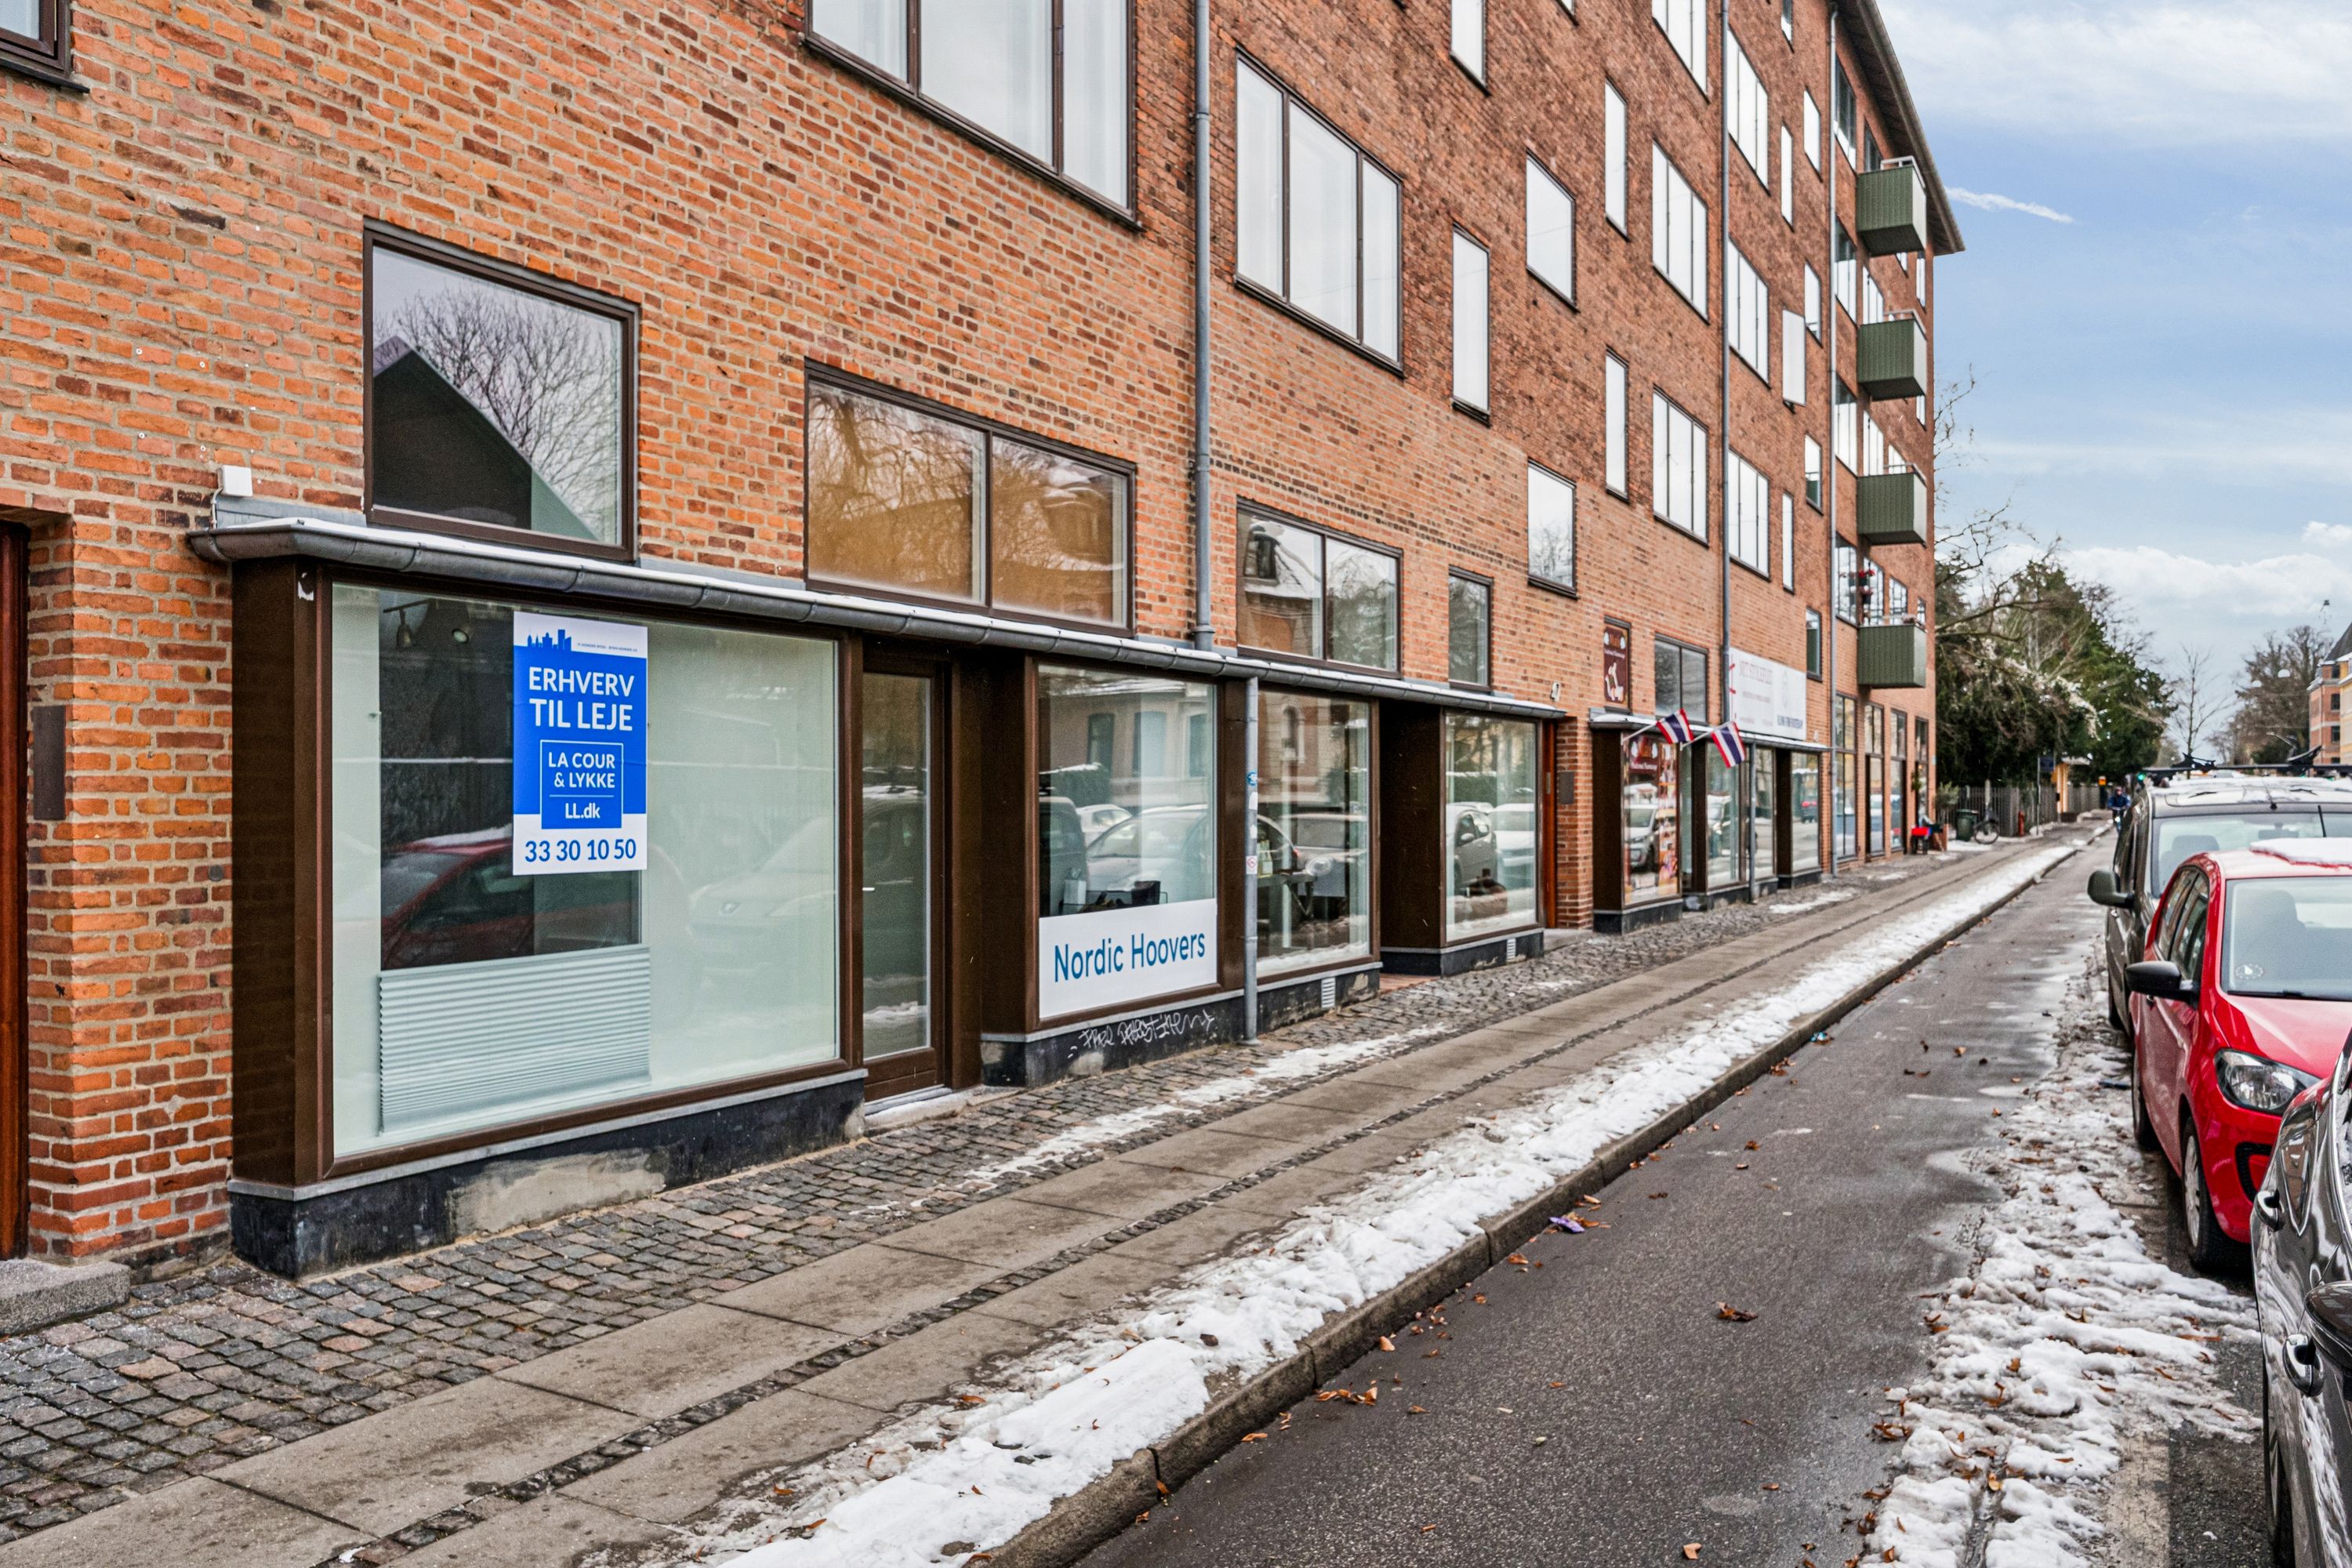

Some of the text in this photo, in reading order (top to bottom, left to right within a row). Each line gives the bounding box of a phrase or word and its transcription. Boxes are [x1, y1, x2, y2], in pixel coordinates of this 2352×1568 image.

[528, 666, 635, 697] ERHVERV
[528, 698, 633, 731] TIL LEJE
[548, 751, 615, 769] LA COUR
[554, 771, 615, 789] & LYKKE
[564, 802, 601, 819] LL.dk
[524, 838, 637, 862] 33 30 10 50
[1054, 932, 1205, 983] Nordic Hoovers
